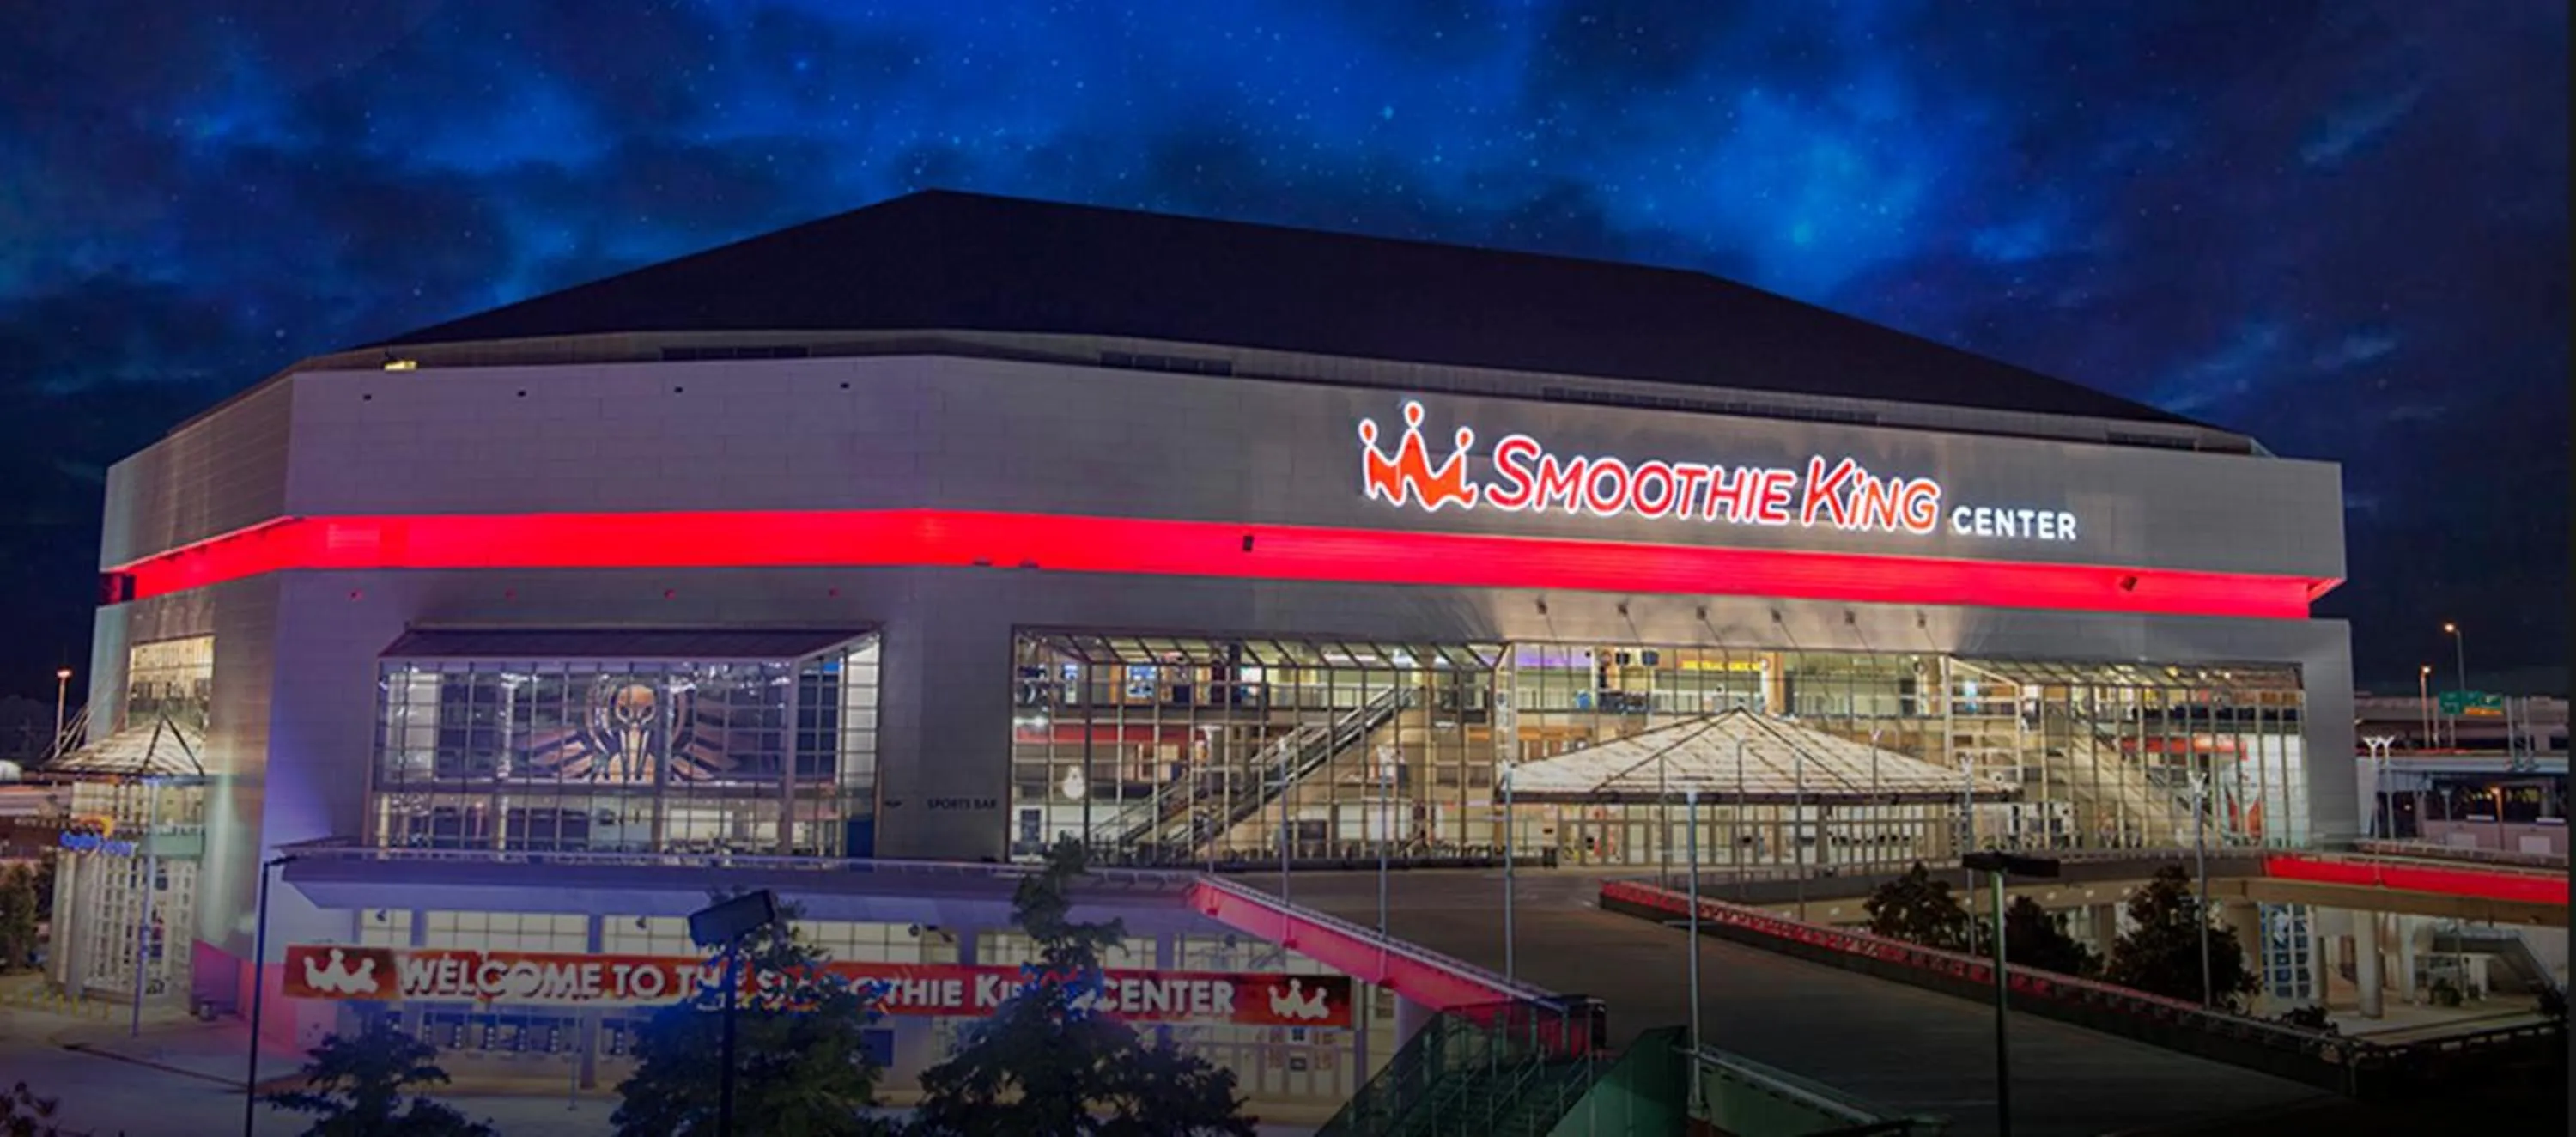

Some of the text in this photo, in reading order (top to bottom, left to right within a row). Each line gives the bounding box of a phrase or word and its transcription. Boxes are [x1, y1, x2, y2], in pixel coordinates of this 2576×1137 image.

[1485, 434, 1797, 525] SMOOTHIE
[1952, 506, 2077, 541] CENTER
[398, 958, 600, 997] WELCOME
[612, 964, 665, 999] TO
[675, 964, 744, 1001] TH
[756, 969, 963, 1008] SOTHIE
[1095, 977, 1234, 1013] CENTER
